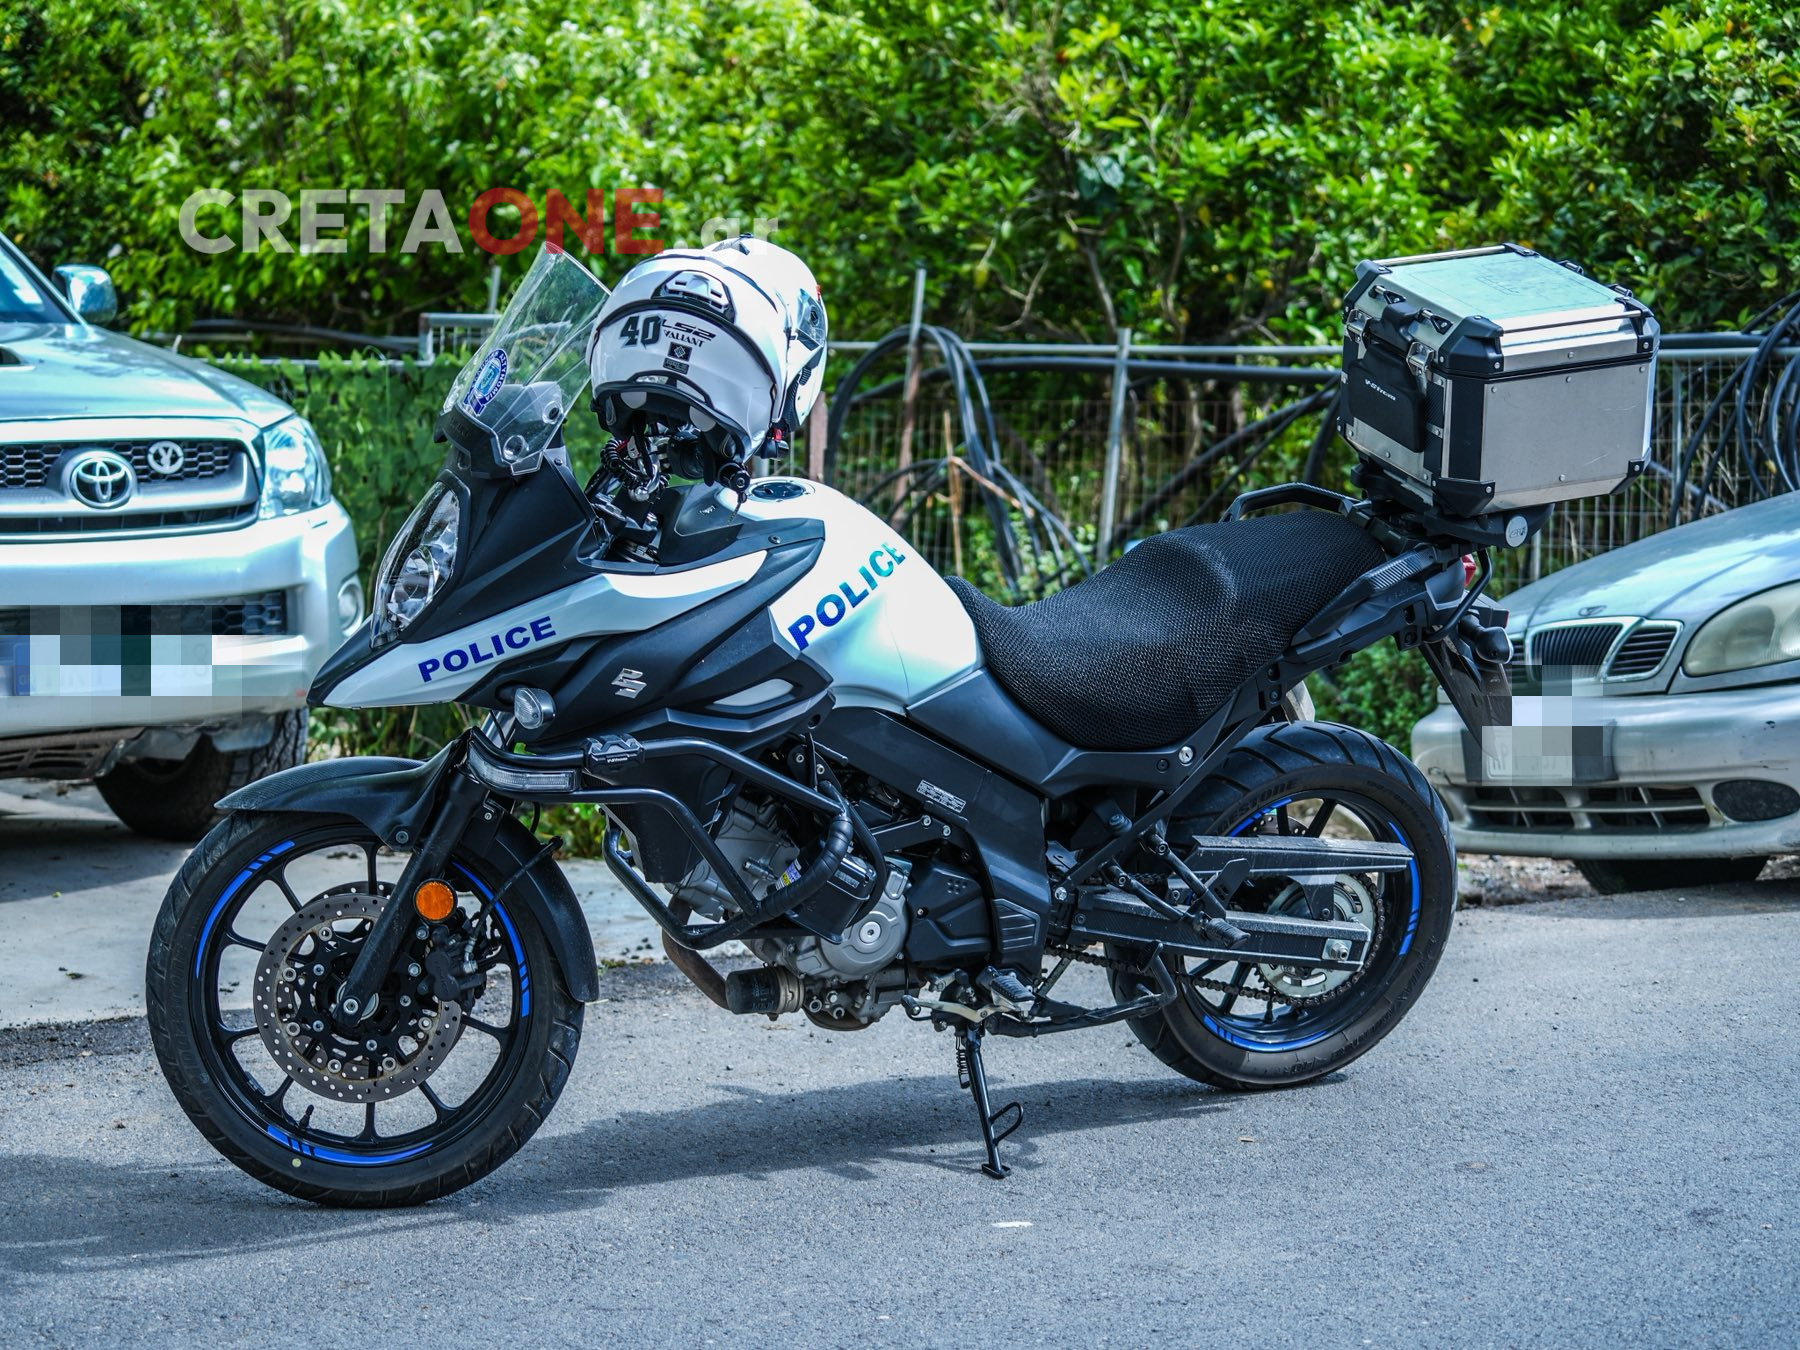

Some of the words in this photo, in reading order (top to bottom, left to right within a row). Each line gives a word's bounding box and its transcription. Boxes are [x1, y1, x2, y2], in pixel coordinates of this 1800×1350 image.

[619, 314, 662, 350] 40
[664, 329, 705, 348] VALIANT
[788, 542, 906, 651] POLICE
[418, 616, 557, 683] POLICE
